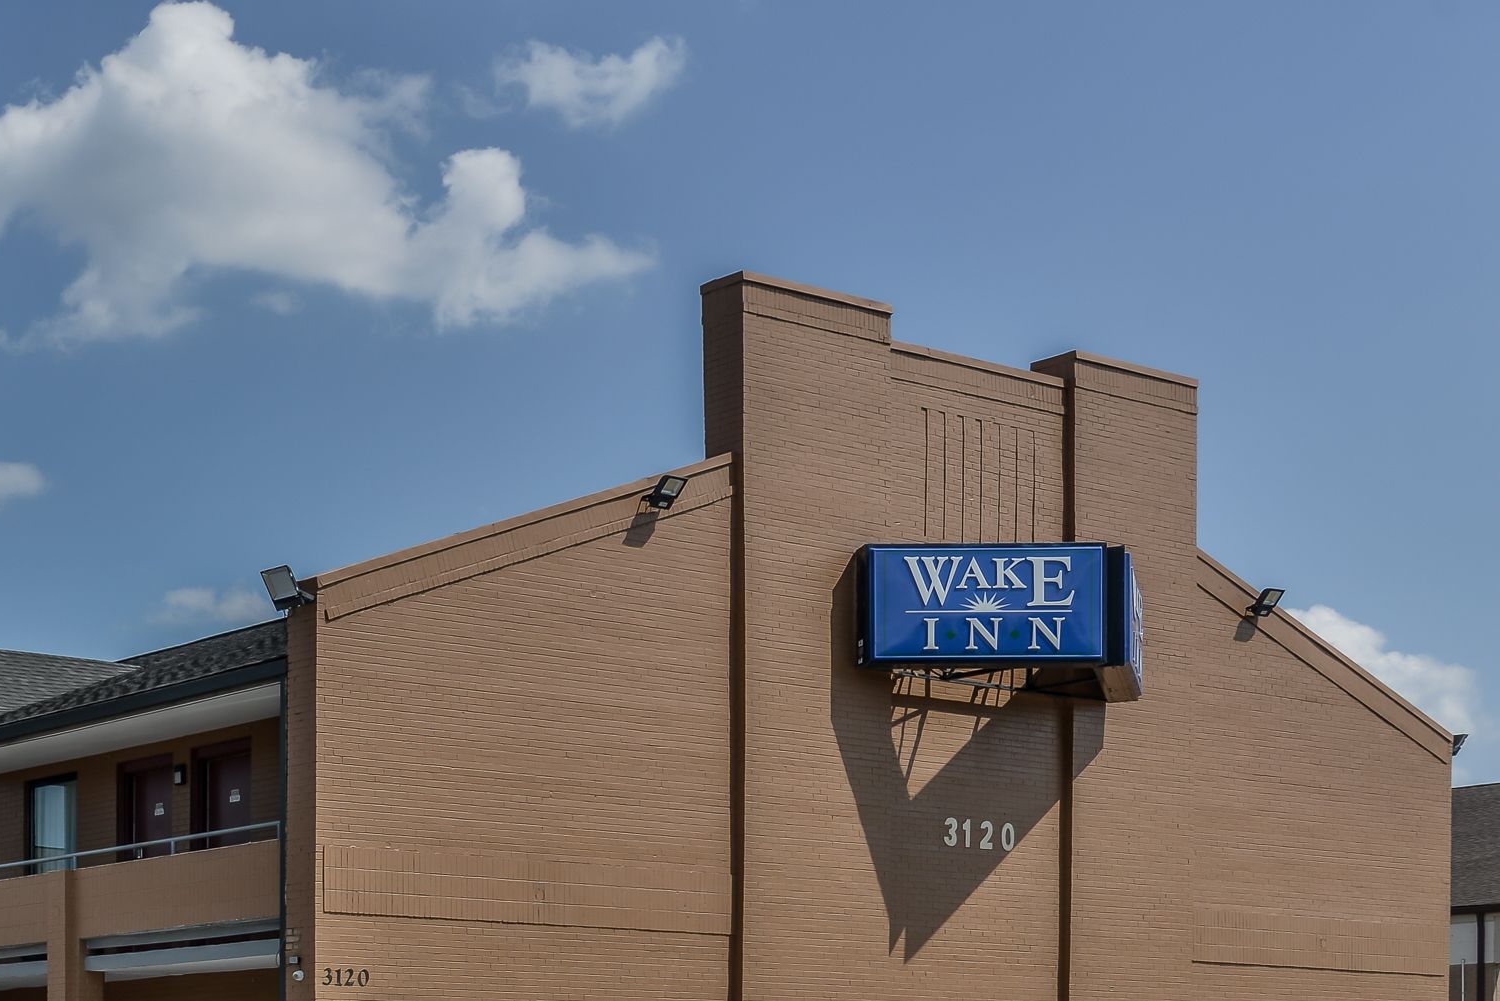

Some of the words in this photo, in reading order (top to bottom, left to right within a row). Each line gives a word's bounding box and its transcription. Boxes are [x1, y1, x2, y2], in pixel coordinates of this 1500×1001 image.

[903, 556, 1075, 607] WAKE
[923, 617, 1066, 650] INN
[943, 817, 1015, 852] 3120
[322, 967, 370, 987] 3120
